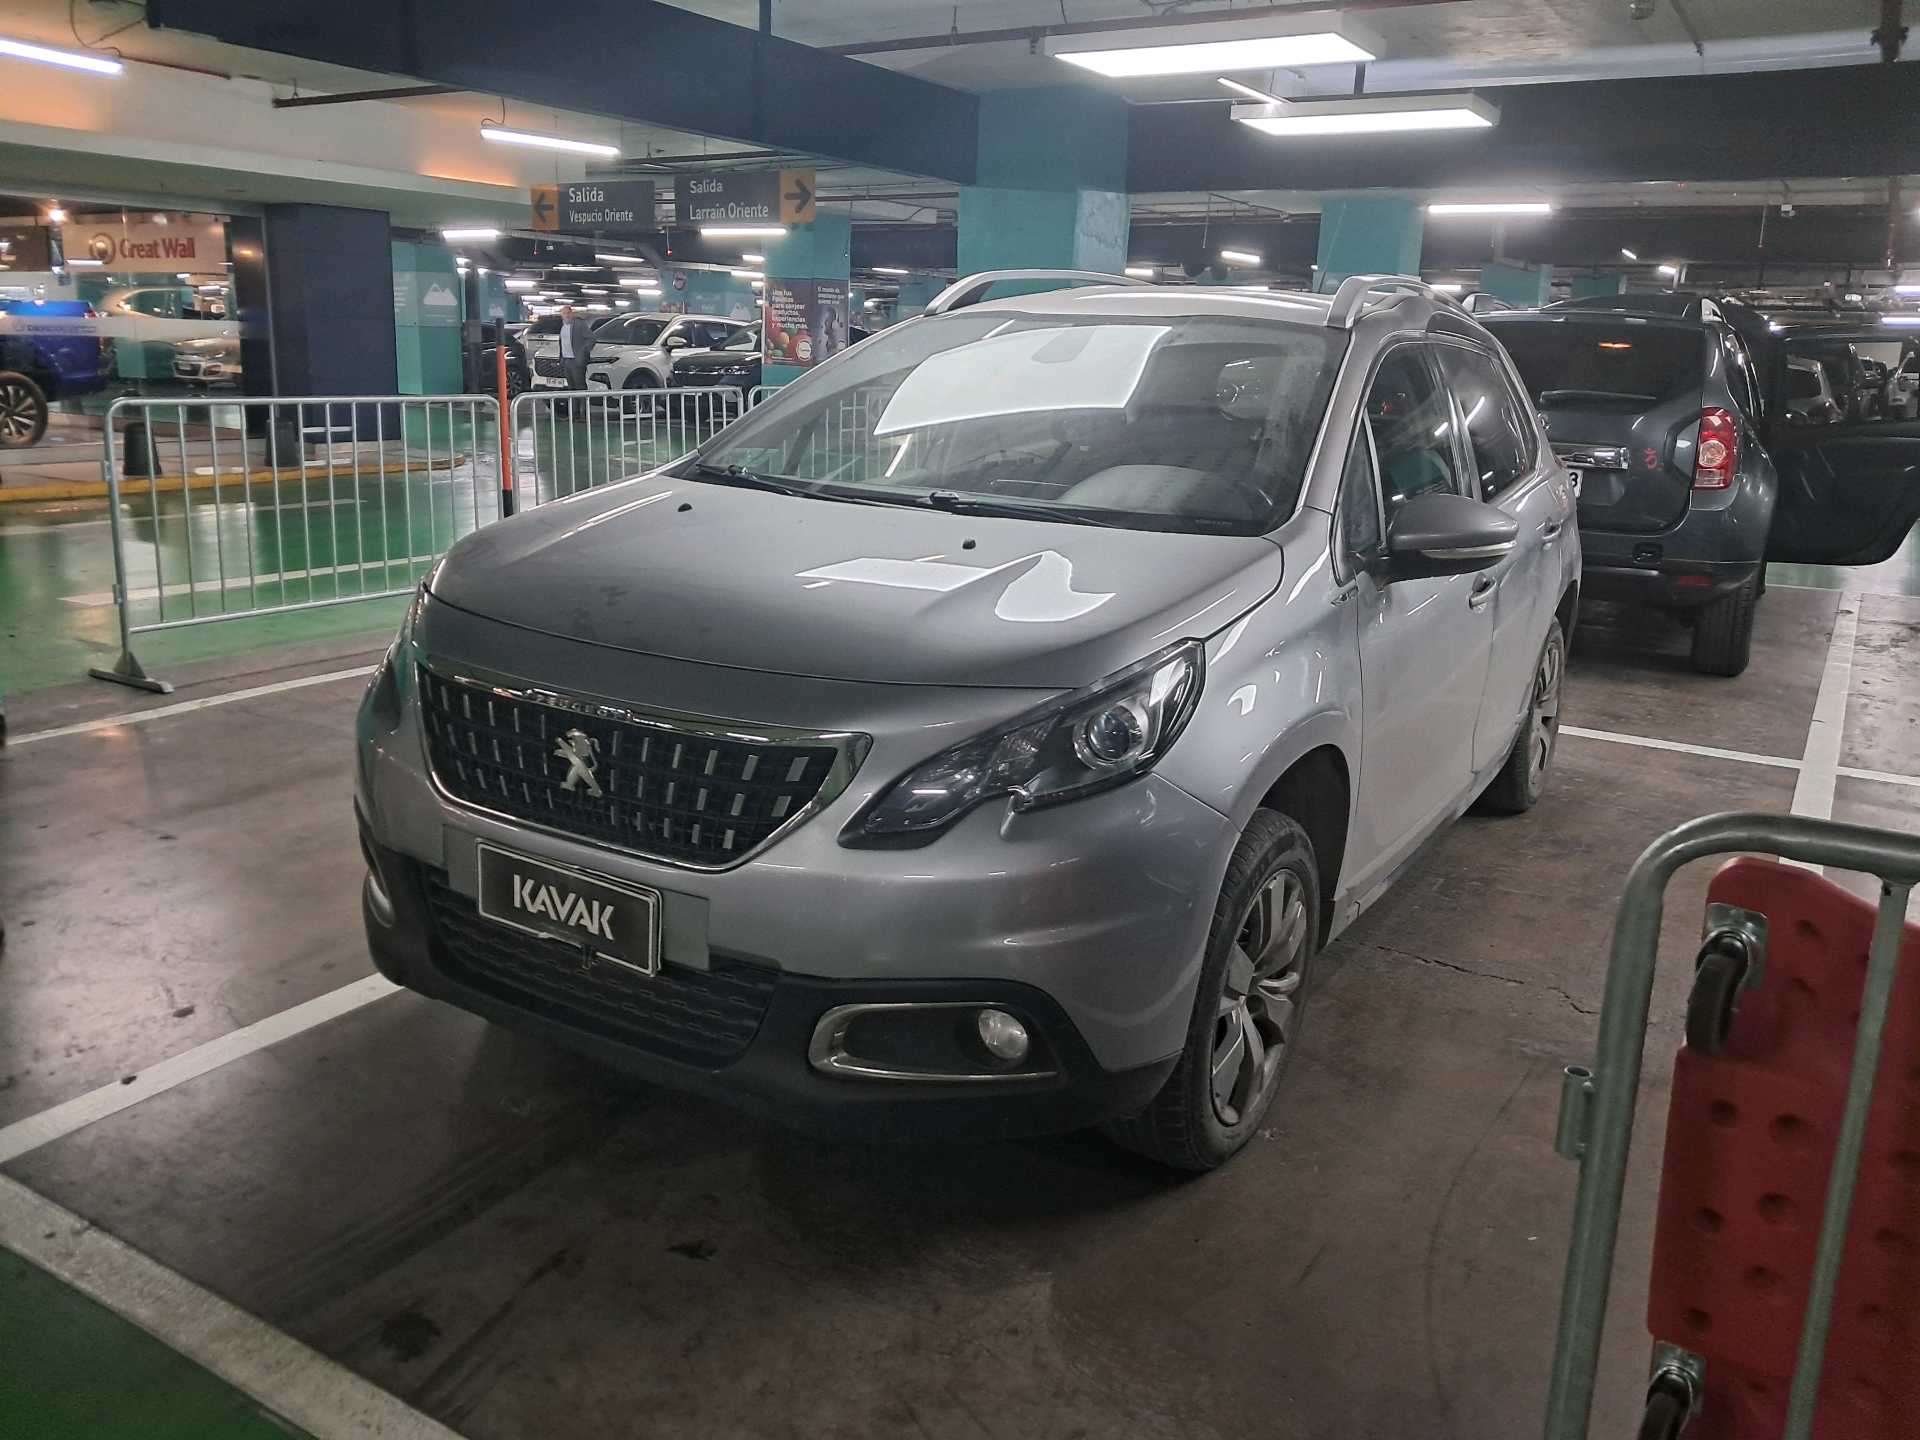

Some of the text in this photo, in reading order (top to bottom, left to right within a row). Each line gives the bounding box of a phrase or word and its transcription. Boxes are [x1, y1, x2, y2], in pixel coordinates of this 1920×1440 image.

[689, 177, 723, 194] Salida
[568, 186, 604, 203] Salida
[569, 207, 633, 224] Vespucio Oriente
[728, 201, 769, 218] Oriente
[119, 237, 196, 258] Great Wall
[513, 873, 615, 941] KAVAK
